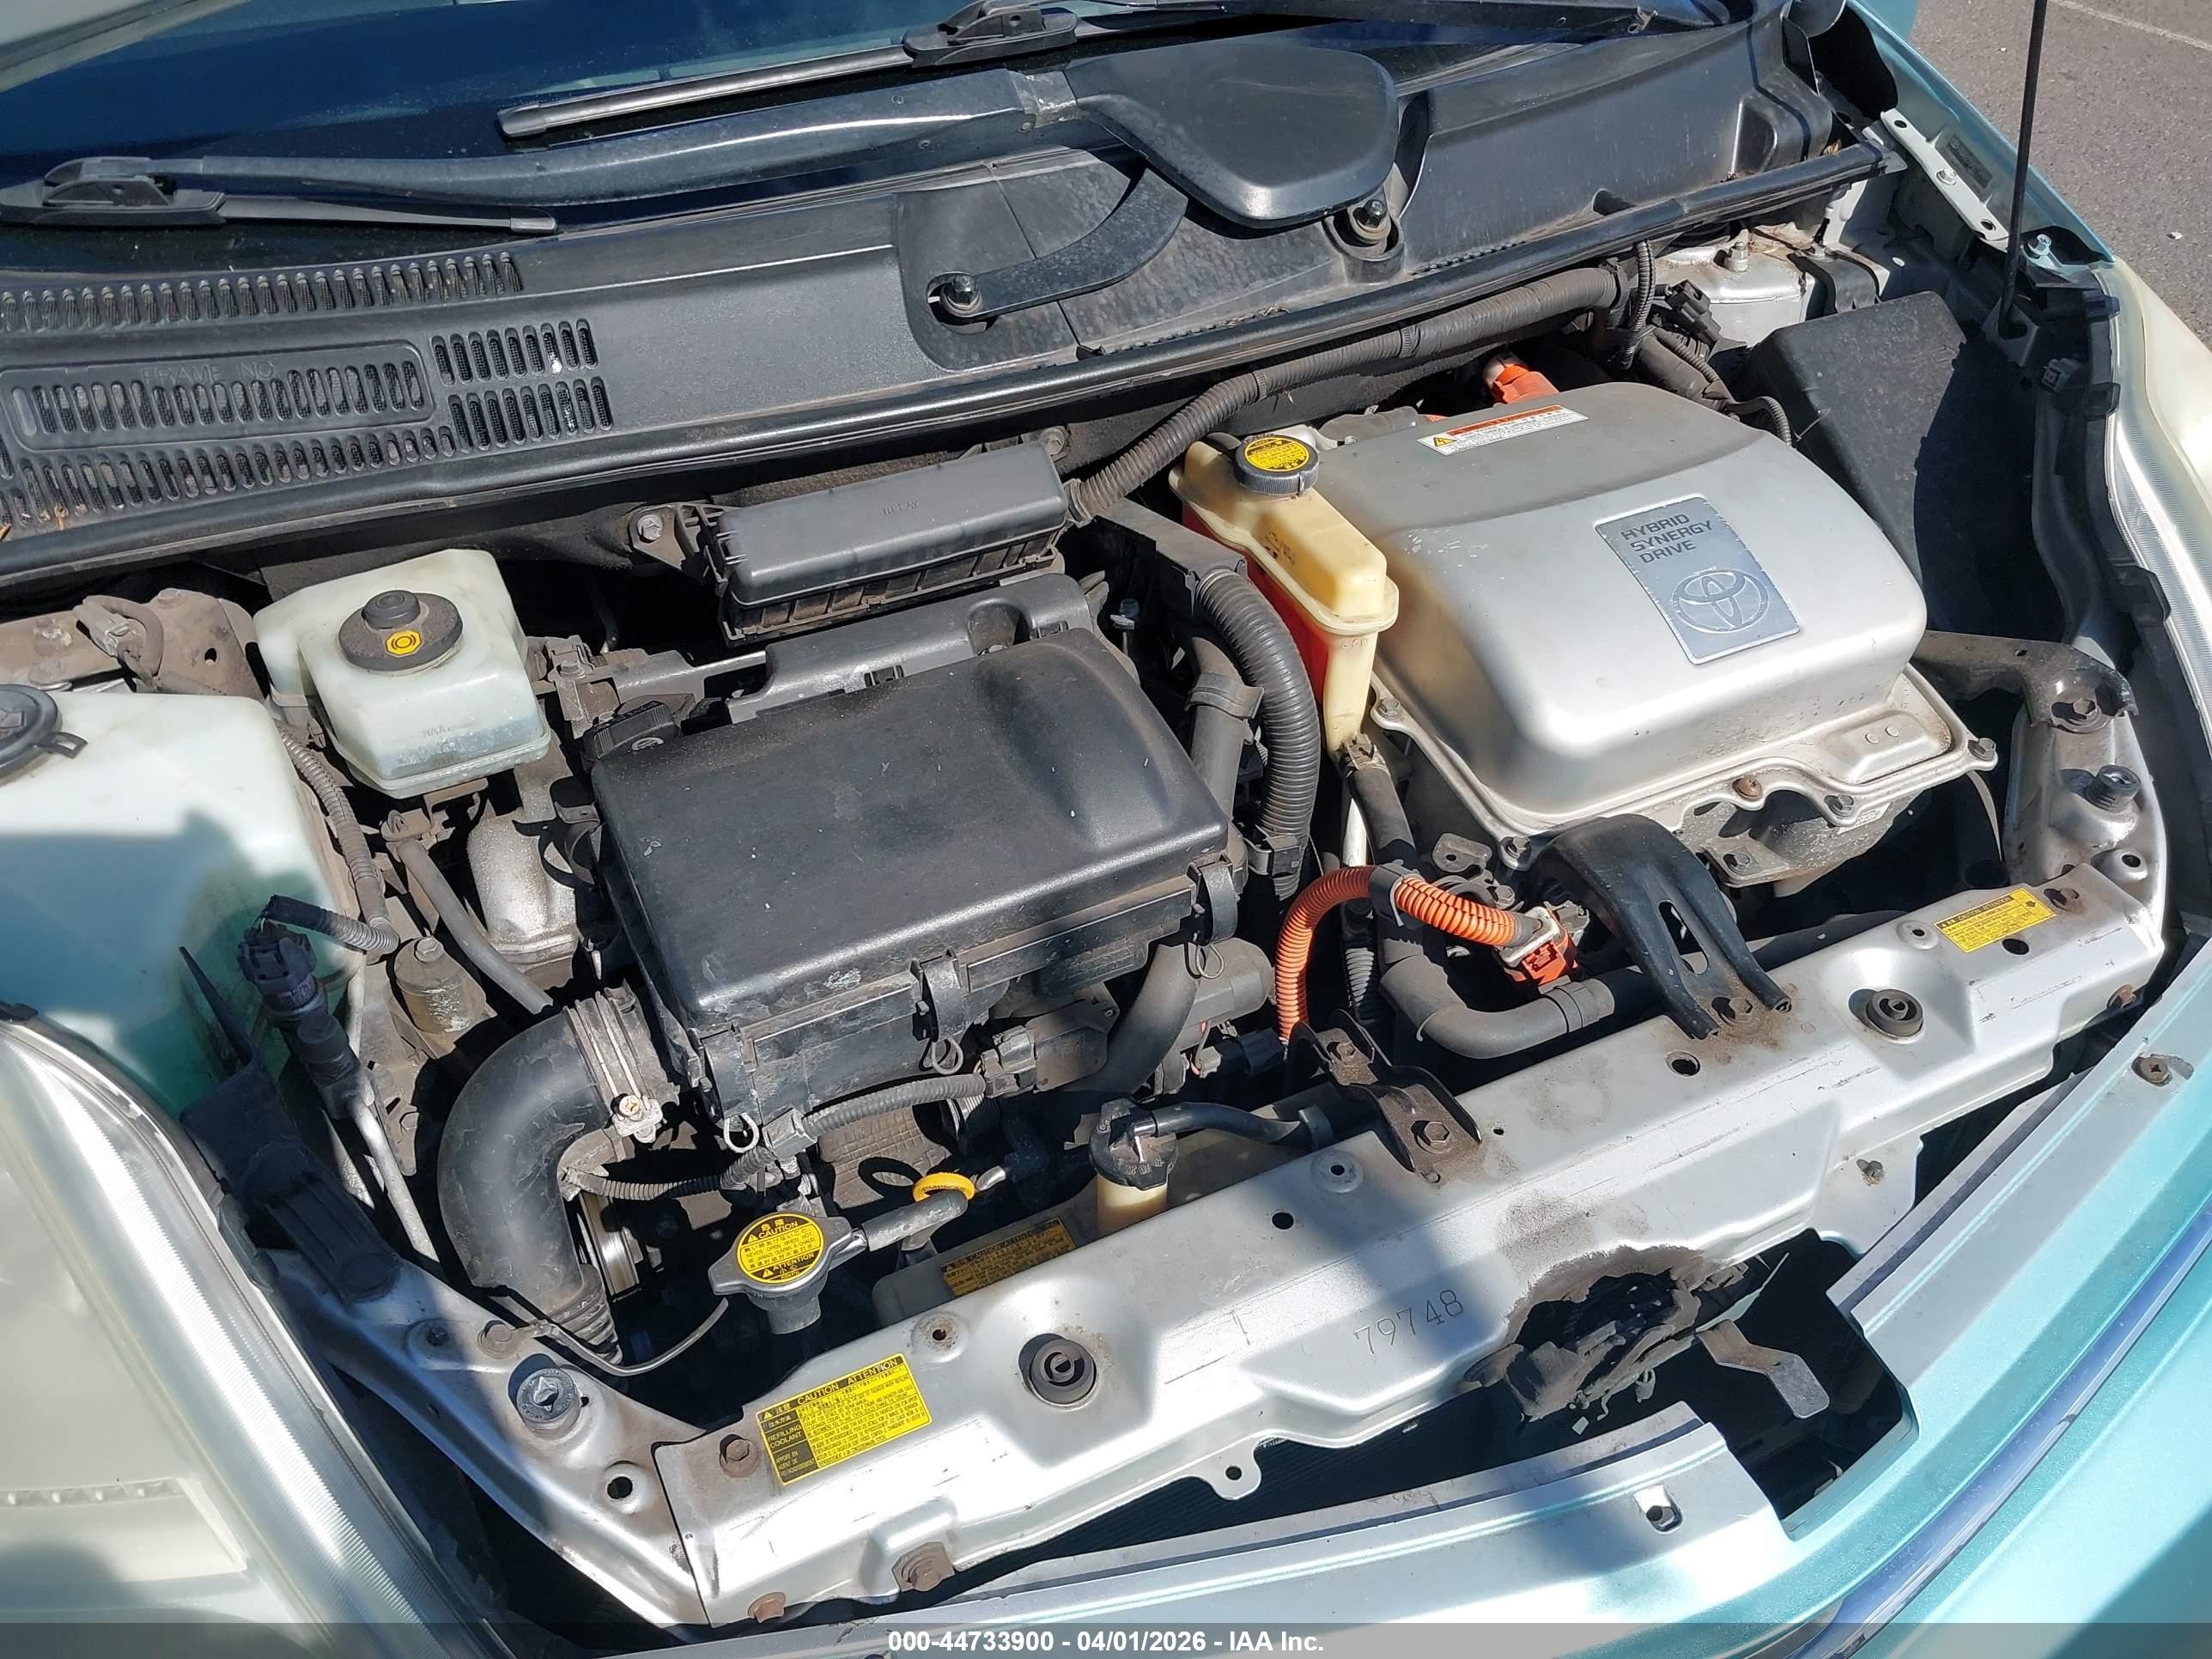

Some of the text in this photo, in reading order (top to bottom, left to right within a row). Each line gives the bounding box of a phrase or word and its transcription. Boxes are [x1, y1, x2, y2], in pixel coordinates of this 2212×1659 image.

[142, 361, 274, 386] FRAME NO
[1621, 514, 1690, 540] HYBRID
[1630, 520, 1712, 551] SYNERGY
[1639, 540, 1696, 563] DRIVE
[758, 1220, 799, 1238] CAUTION
[745, 1249, 763, 1258] NEVER
[766, 1243, 781, 1252] OPEN
[801, 1231, 812, 1240] HOT
[773, 1252, 815, 1271] ATTENTION
[1353, 1289, 1463, 1355] 79748
[797, 1382, 840, 1405] CAUTION
[847, 1358, 898, 1385] ATTENTION
[767, 1425, 802, 1442] REFILLING
[769, 1431, 803, 1449] COOLANT
